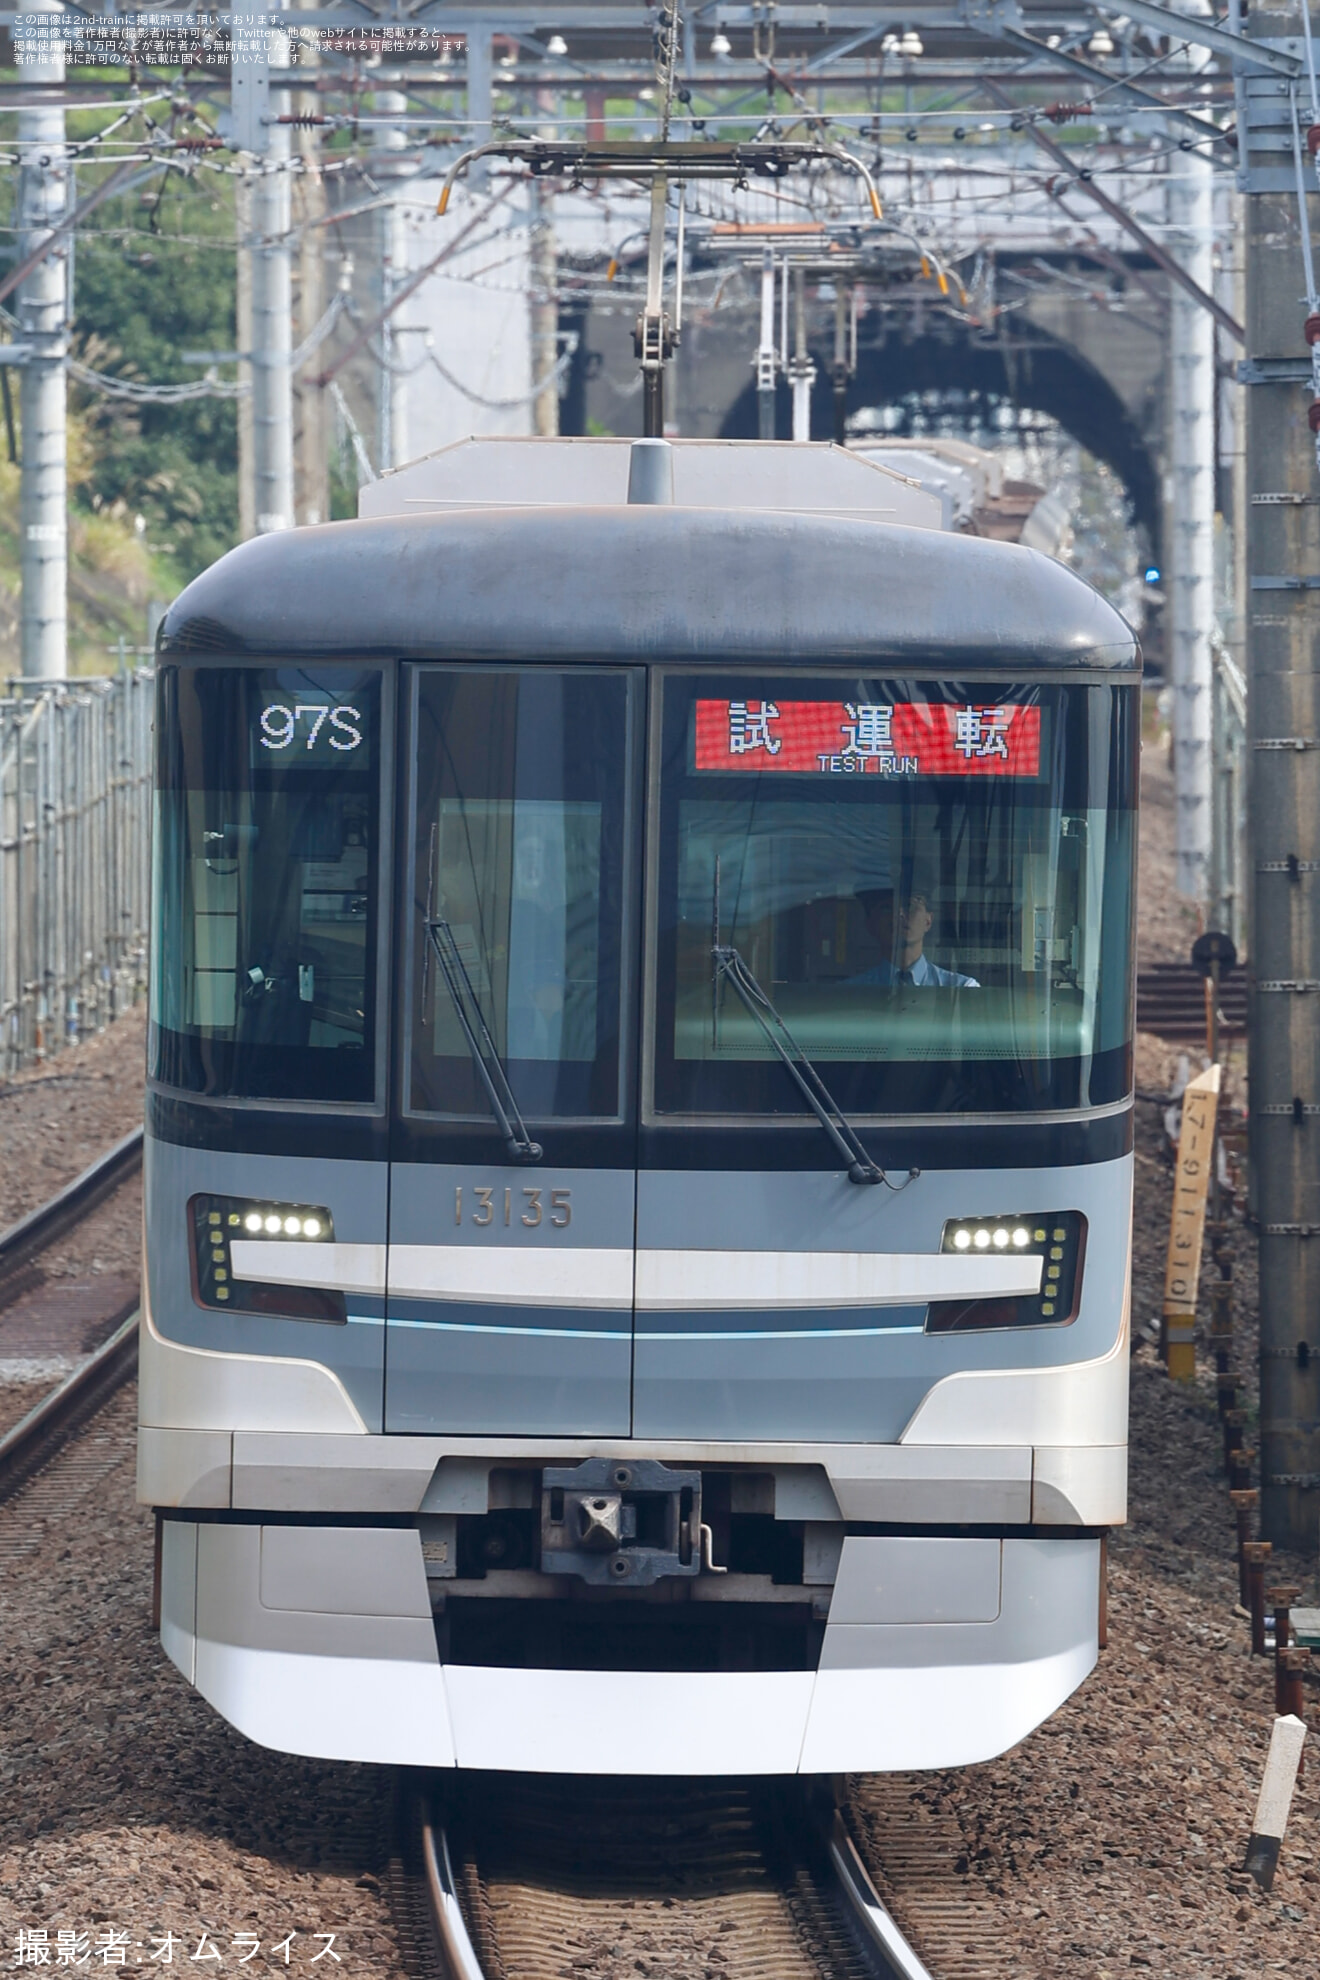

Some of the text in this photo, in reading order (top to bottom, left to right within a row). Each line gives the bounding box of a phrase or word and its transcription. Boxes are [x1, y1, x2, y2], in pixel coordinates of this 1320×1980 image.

[260, 705, 362, 750] 97S
[728, 701, 1009, 758] 試運転
[817, 756, 918, 774] TEST RUN
[455, 1186, 571, 1227] 13135
